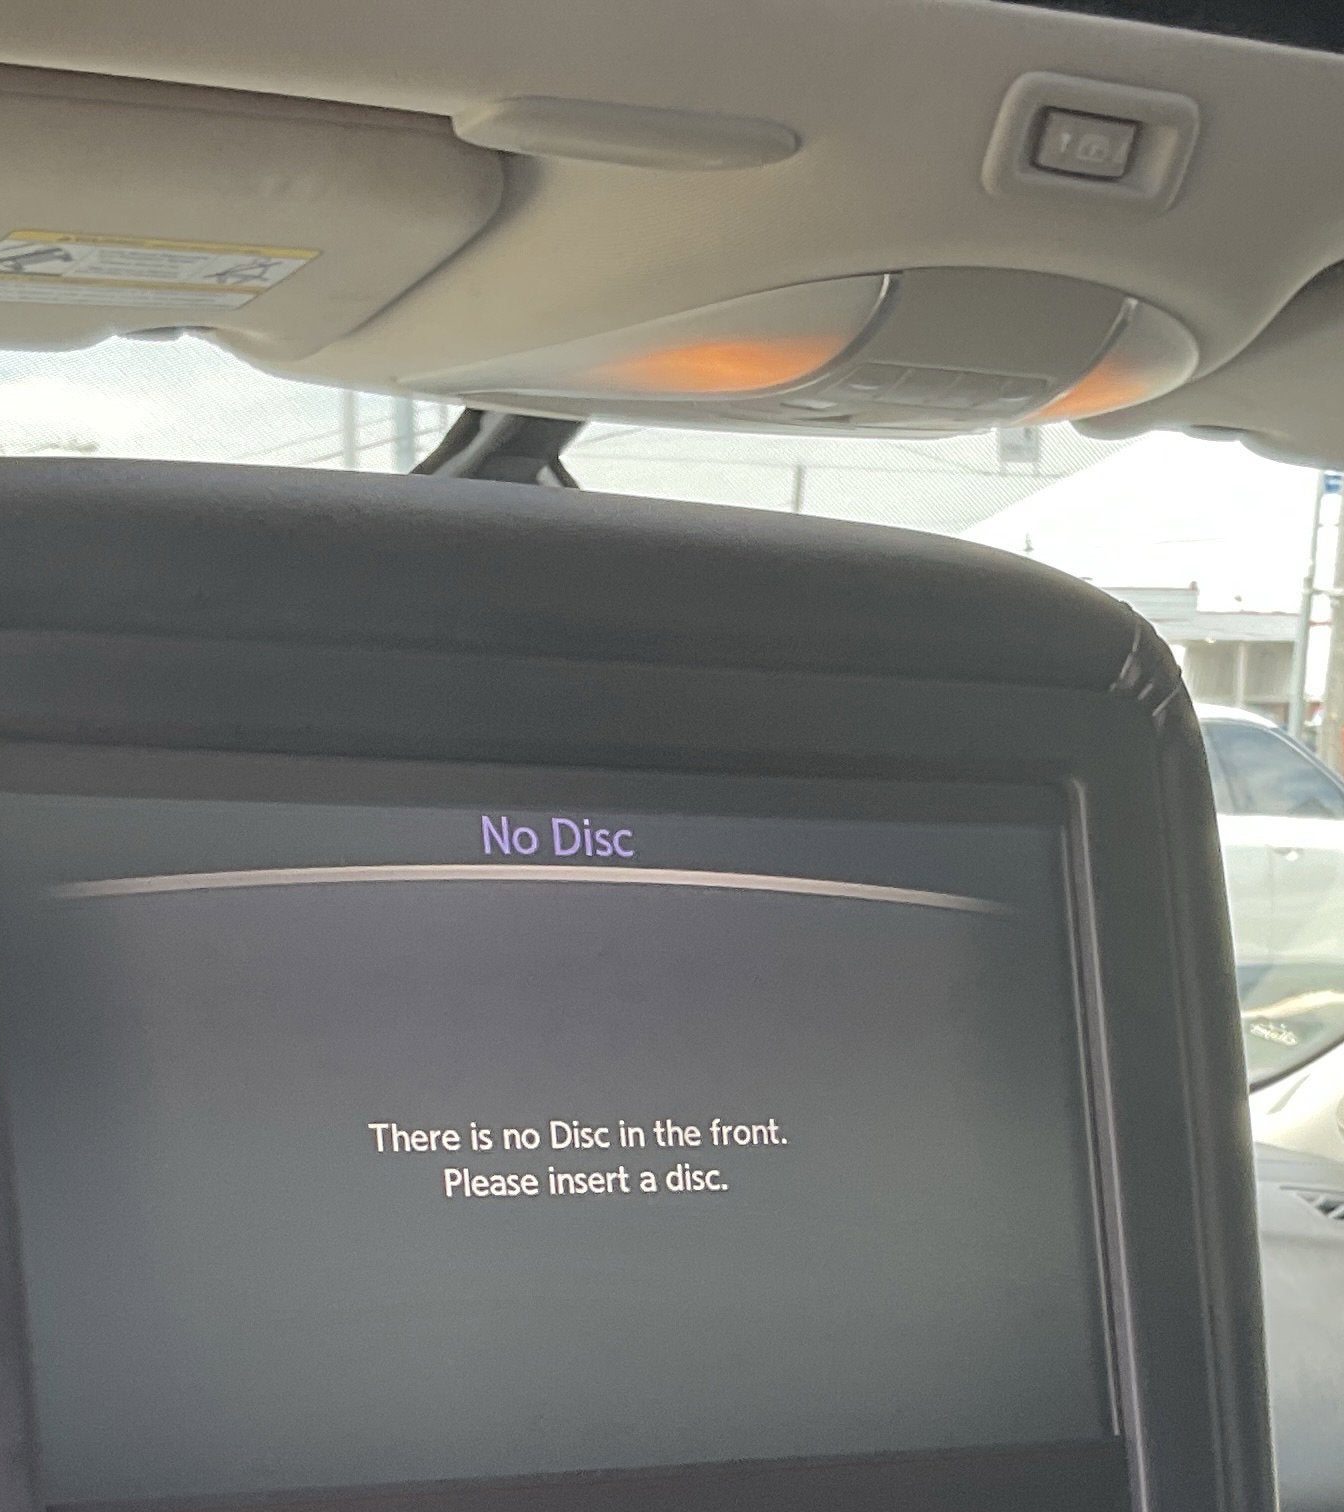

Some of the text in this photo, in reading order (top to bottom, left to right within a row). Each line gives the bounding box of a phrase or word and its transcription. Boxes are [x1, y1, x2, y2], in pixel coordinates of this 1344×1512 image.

[481, 815, 635, 858] No Disc
[367, 1117, 788, 1152] There is no Disc in the front.
[443, 1162, 729, 1198] Please insert a disc.
